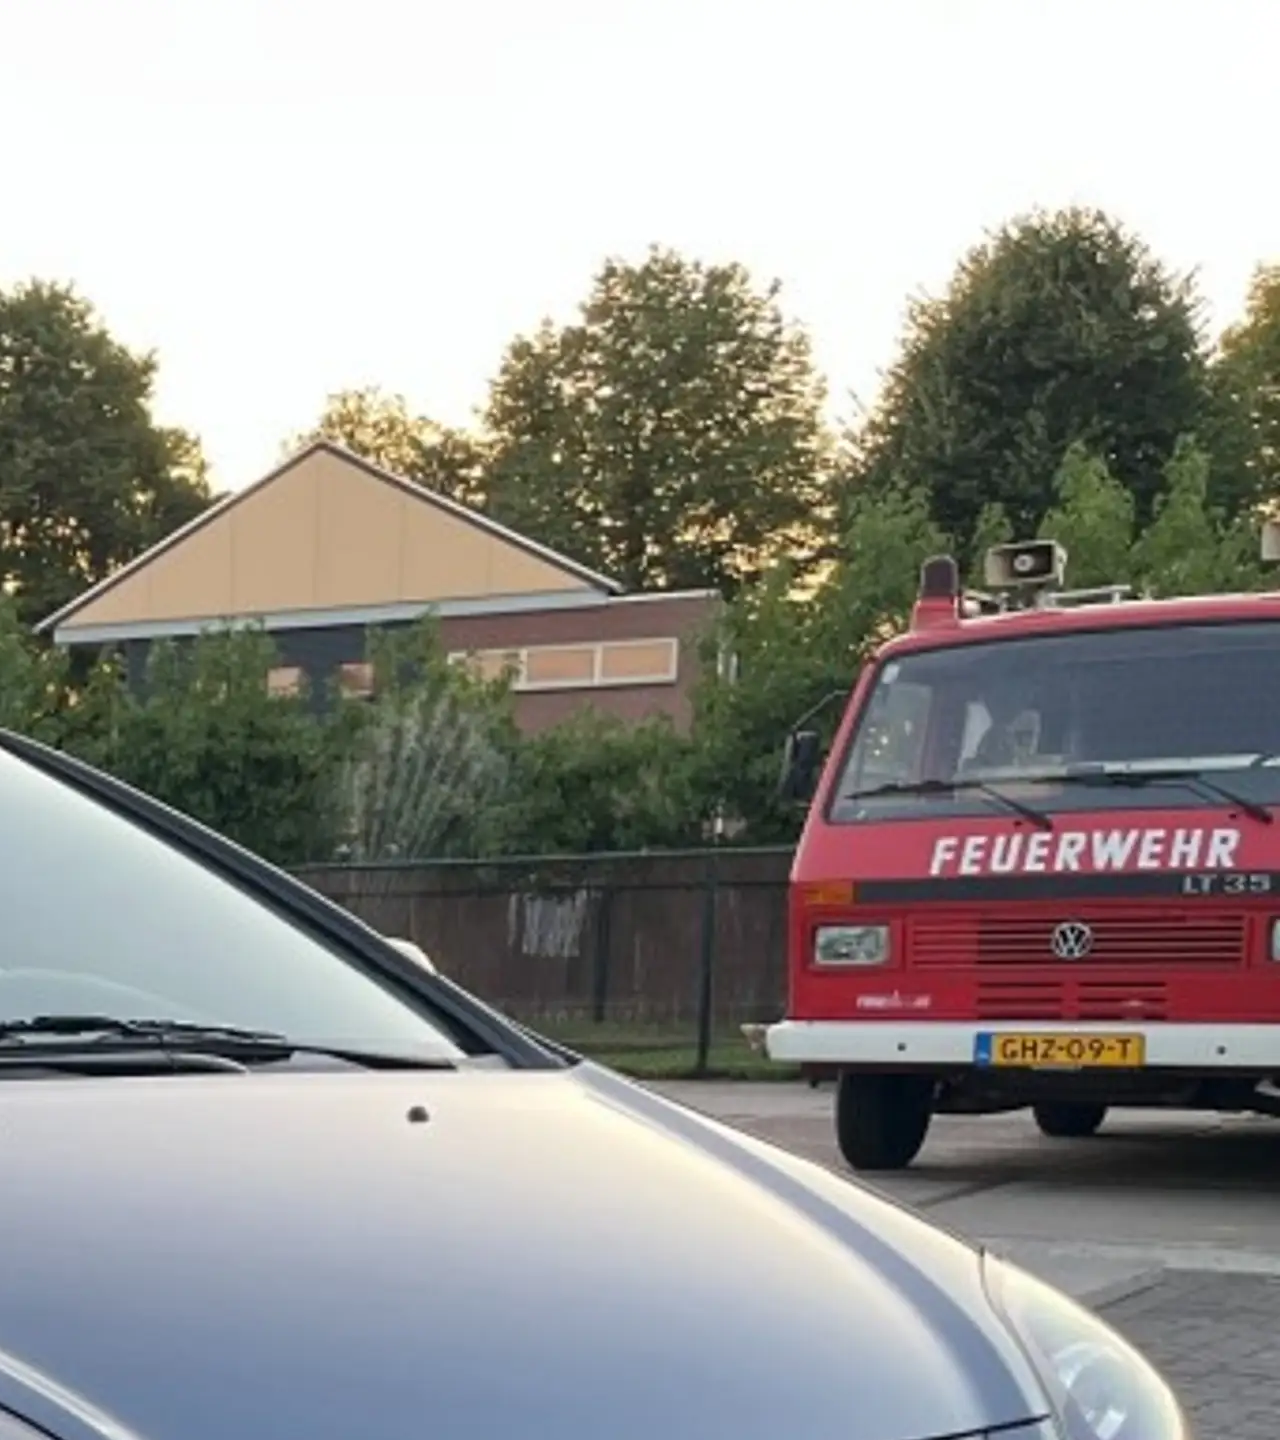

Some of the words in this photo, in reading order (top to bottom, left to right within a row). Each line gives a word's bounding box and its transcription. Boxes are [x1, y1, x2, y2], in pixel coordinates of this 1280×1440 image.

[928, 828, 1240, 876] FEUERWEHR
[1181, 873, 1218, 894] LT
[1222, 873, 1271, 894] 35
[999, 1037, 1133, 1061] GHZ-09-T
